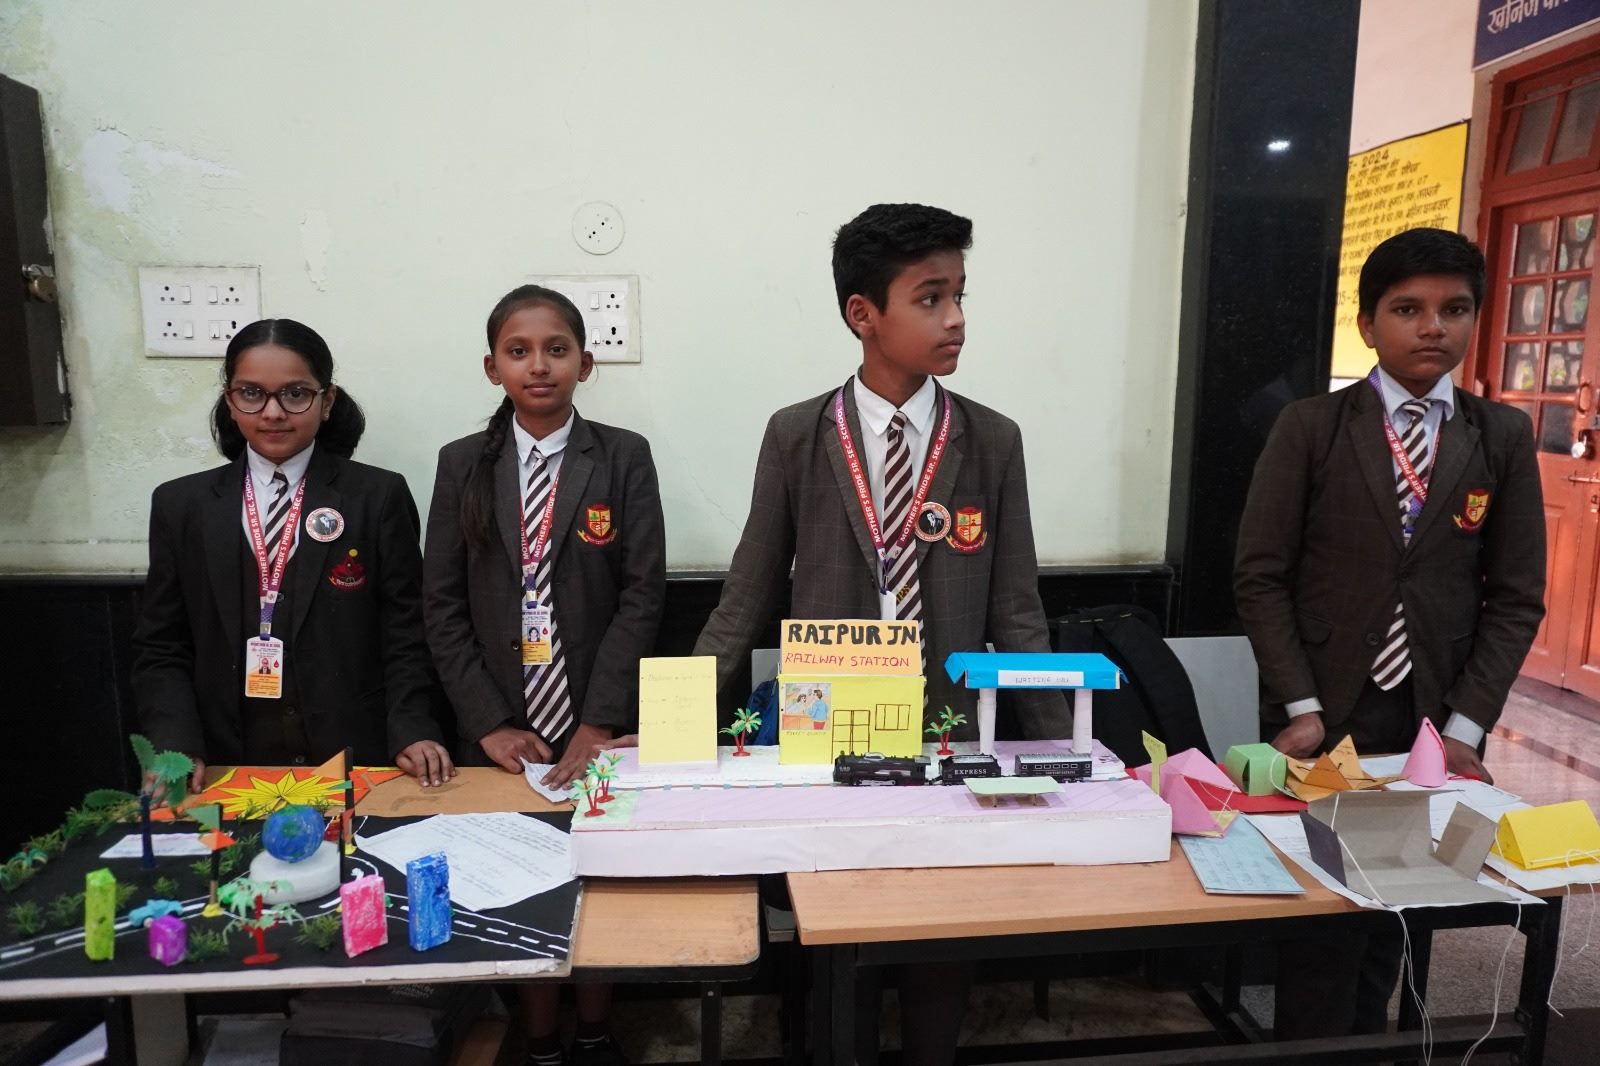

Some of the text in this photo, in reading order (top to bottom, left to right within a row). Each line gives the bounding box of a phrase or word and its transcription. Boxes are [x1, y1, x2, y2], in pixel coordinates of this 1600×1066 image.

[1361, 149, 1389, 169] 2024
[837, 406, 880, 542] MOTHER'S PRIDE SR. SEC. SCHOOL
[900, 409, 951, 542] MOTHER'S PRIDE SR. SEC. SCHOOL
[247, 501, 256, 516] SEC.
[292, 496, 302, 510] SEC.
[251, 515, 259, 527] SR.
[288, 512, 297, 523] SR.
[253, 528, 264, 550] PRIDE
[281, 523, 294, 546] PRIDE
[533, 519, 548, 558] MOTHER'S
[258, 551, 269, 591] MOTHER'S
[271, 547, 287, 586] MOTHER'S
[787, 623, 919, 645] RAIPUR JN.
[785, 652, 910, 667] RAILWAY STATION
